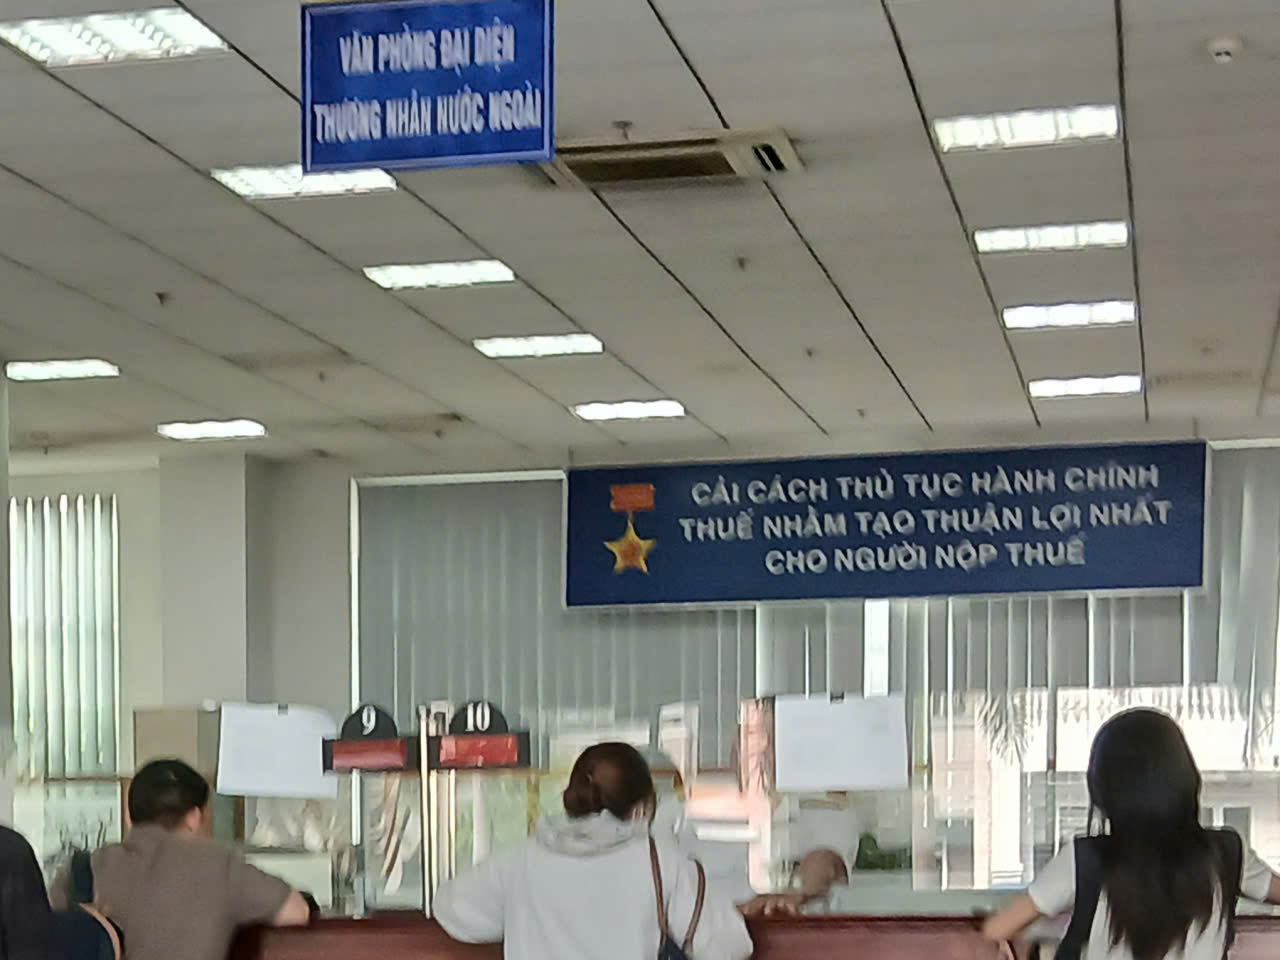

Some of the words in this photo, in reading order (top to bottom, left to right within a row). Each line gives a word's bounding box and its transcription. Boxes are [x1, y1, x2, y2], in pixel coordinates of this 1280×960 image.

[747, 473, 829, 505] CÁCH
[902, 472, 964, 501] TỤC
[971, 464, 1056, 496] HÀNH
[1064, 460, 1160, 493] CHÍNH
[678, 507, 754, 543] THUẾ
[854, 509, 916, 540] TẠO
[921, 501, 1023, 536] THUẬN
[1032, 502, 1081, 533] LỢI
[1089, 492, 1173, 527] NHẤT
[765, 548, 828, 576] CHO
[834, 540, 928, 573] NGƯỜI
[934, 538, 999, 573] NỘP
[1004, 531, 1089, 568] THUẾ
[361, 704, 377, 736] 9
[464, 701, 491, 733] 10
